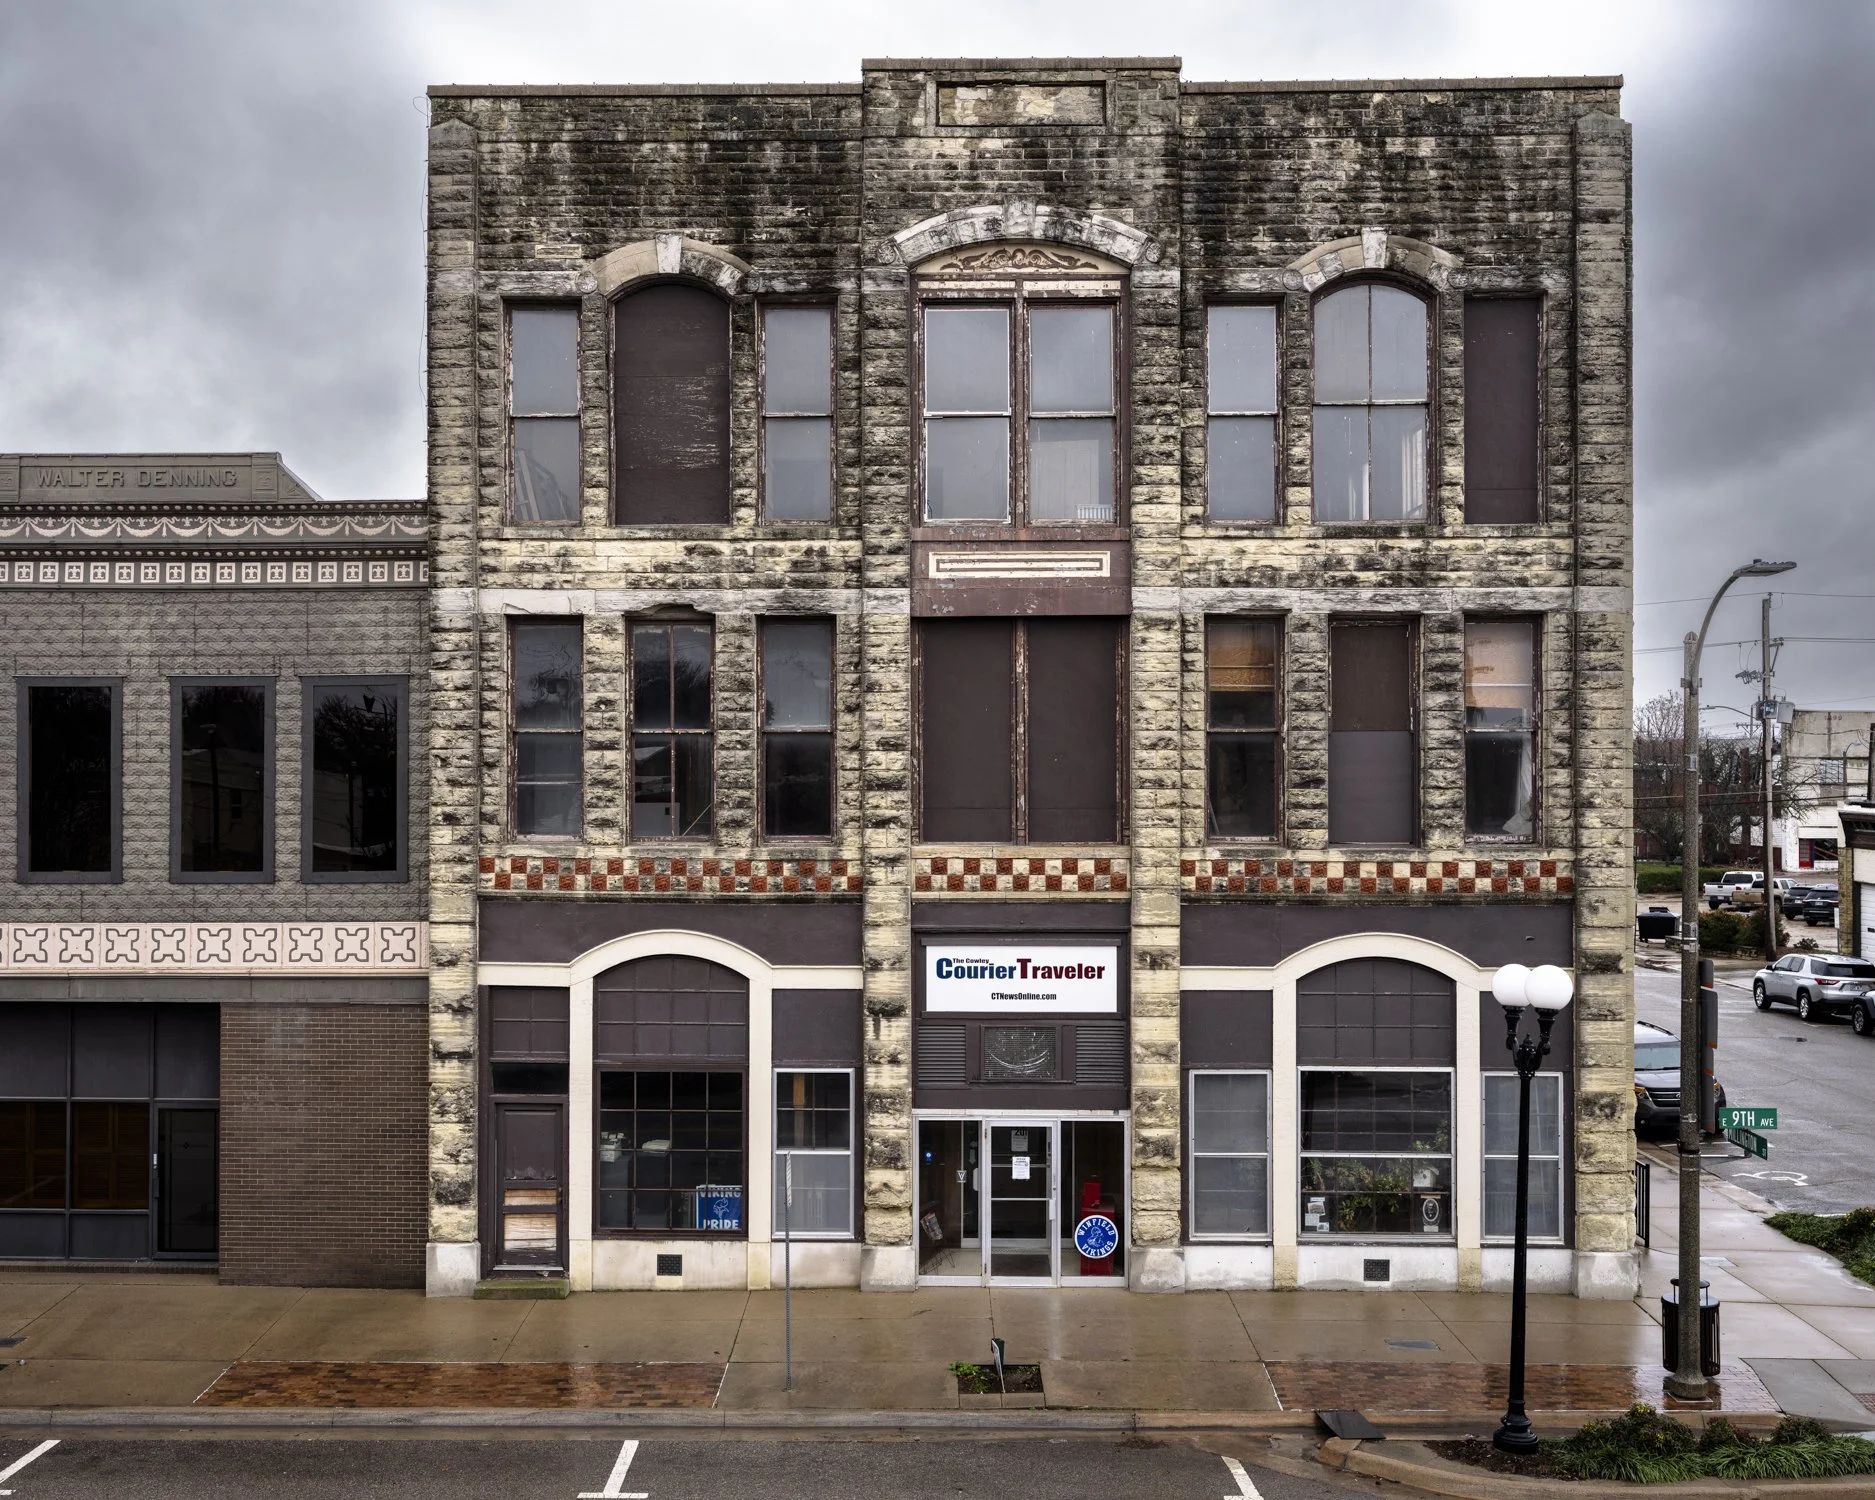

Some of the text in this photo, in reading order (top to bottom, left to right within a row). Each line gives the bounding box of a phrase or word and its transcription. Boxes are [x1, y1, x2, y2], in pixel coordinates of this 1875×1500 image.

[36, 467, 238, 488] WALTER DENNING
[965, 957, 990, 965] Cowley
[991, 992, 1057, 1001] CTNewsOnline.com
[1722, 1110, 1774, 1127] E 9TH AVE
[700, 1187, 742, 1198] VIKING
[703, 1219, 739, 1230] PRIDE
[1078, 1218, 1115, 1236] WINFIELD
[1082, 1240, 1114, 1256] VIKINGS
